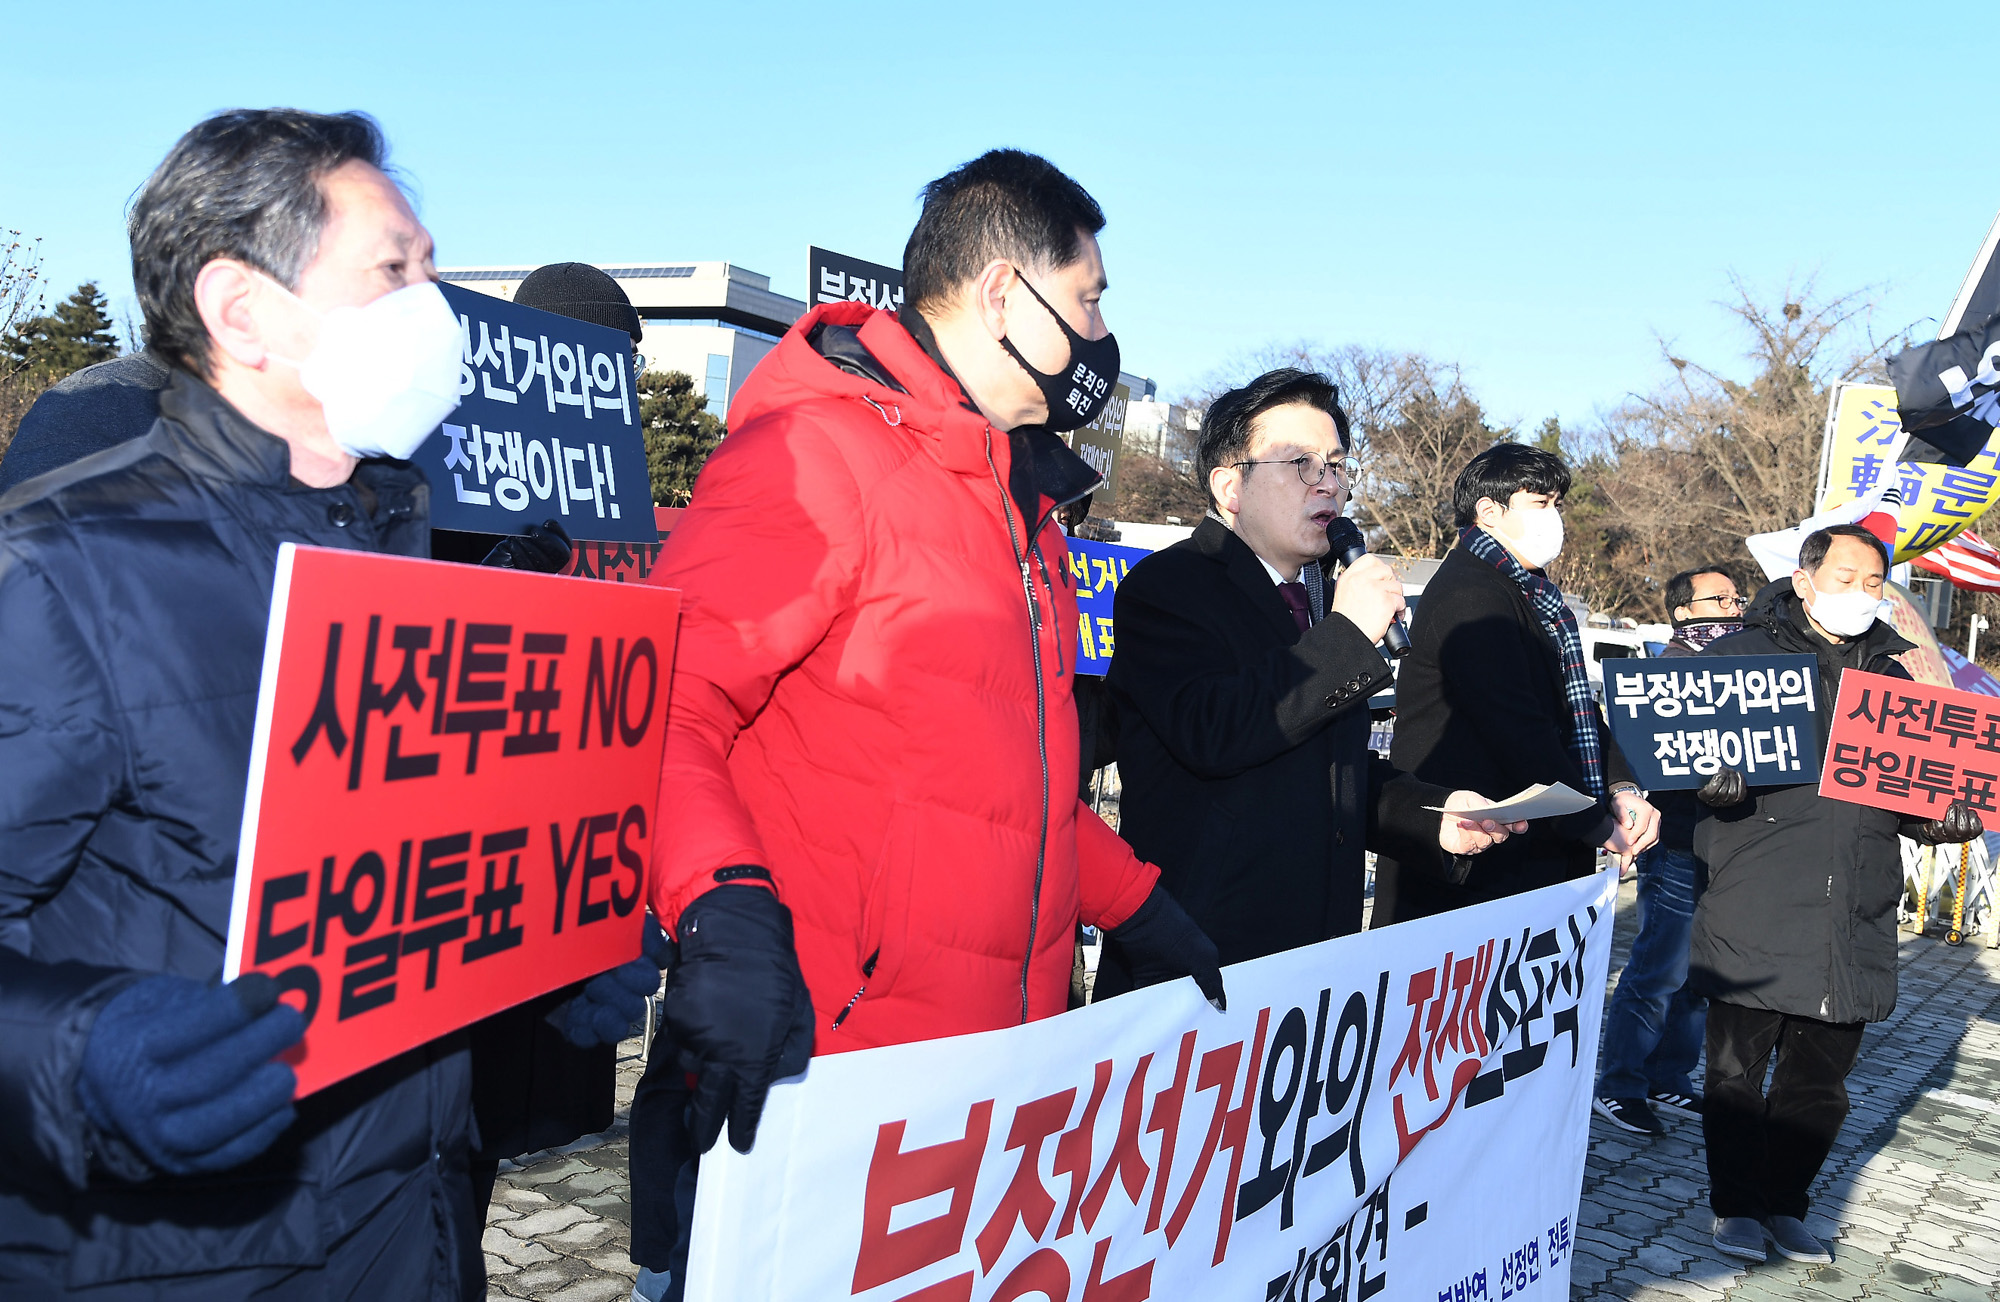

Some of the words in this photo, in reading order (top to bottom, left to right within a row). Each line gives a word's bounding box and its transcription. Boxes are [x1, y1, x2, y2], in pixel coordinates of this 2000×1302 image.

[1065, 387, 1093, 416] 퇴진
[1071, 362, 1108, 399] 문죄인
[441, 422, 621, 519] 전쟁이다!
[291, 614, 567, 791] 사전투표
[578, 636, 658, 750] NO
[1614, 666, 1816, 719] 부정선거와의
[1653, 725, 1802, 775] 전쟁이다!
[1833, 742, 1998, 812] 당일투표
[253, 827, 529, 1030] 당일투표
[549, 804, 647, 936] YES
